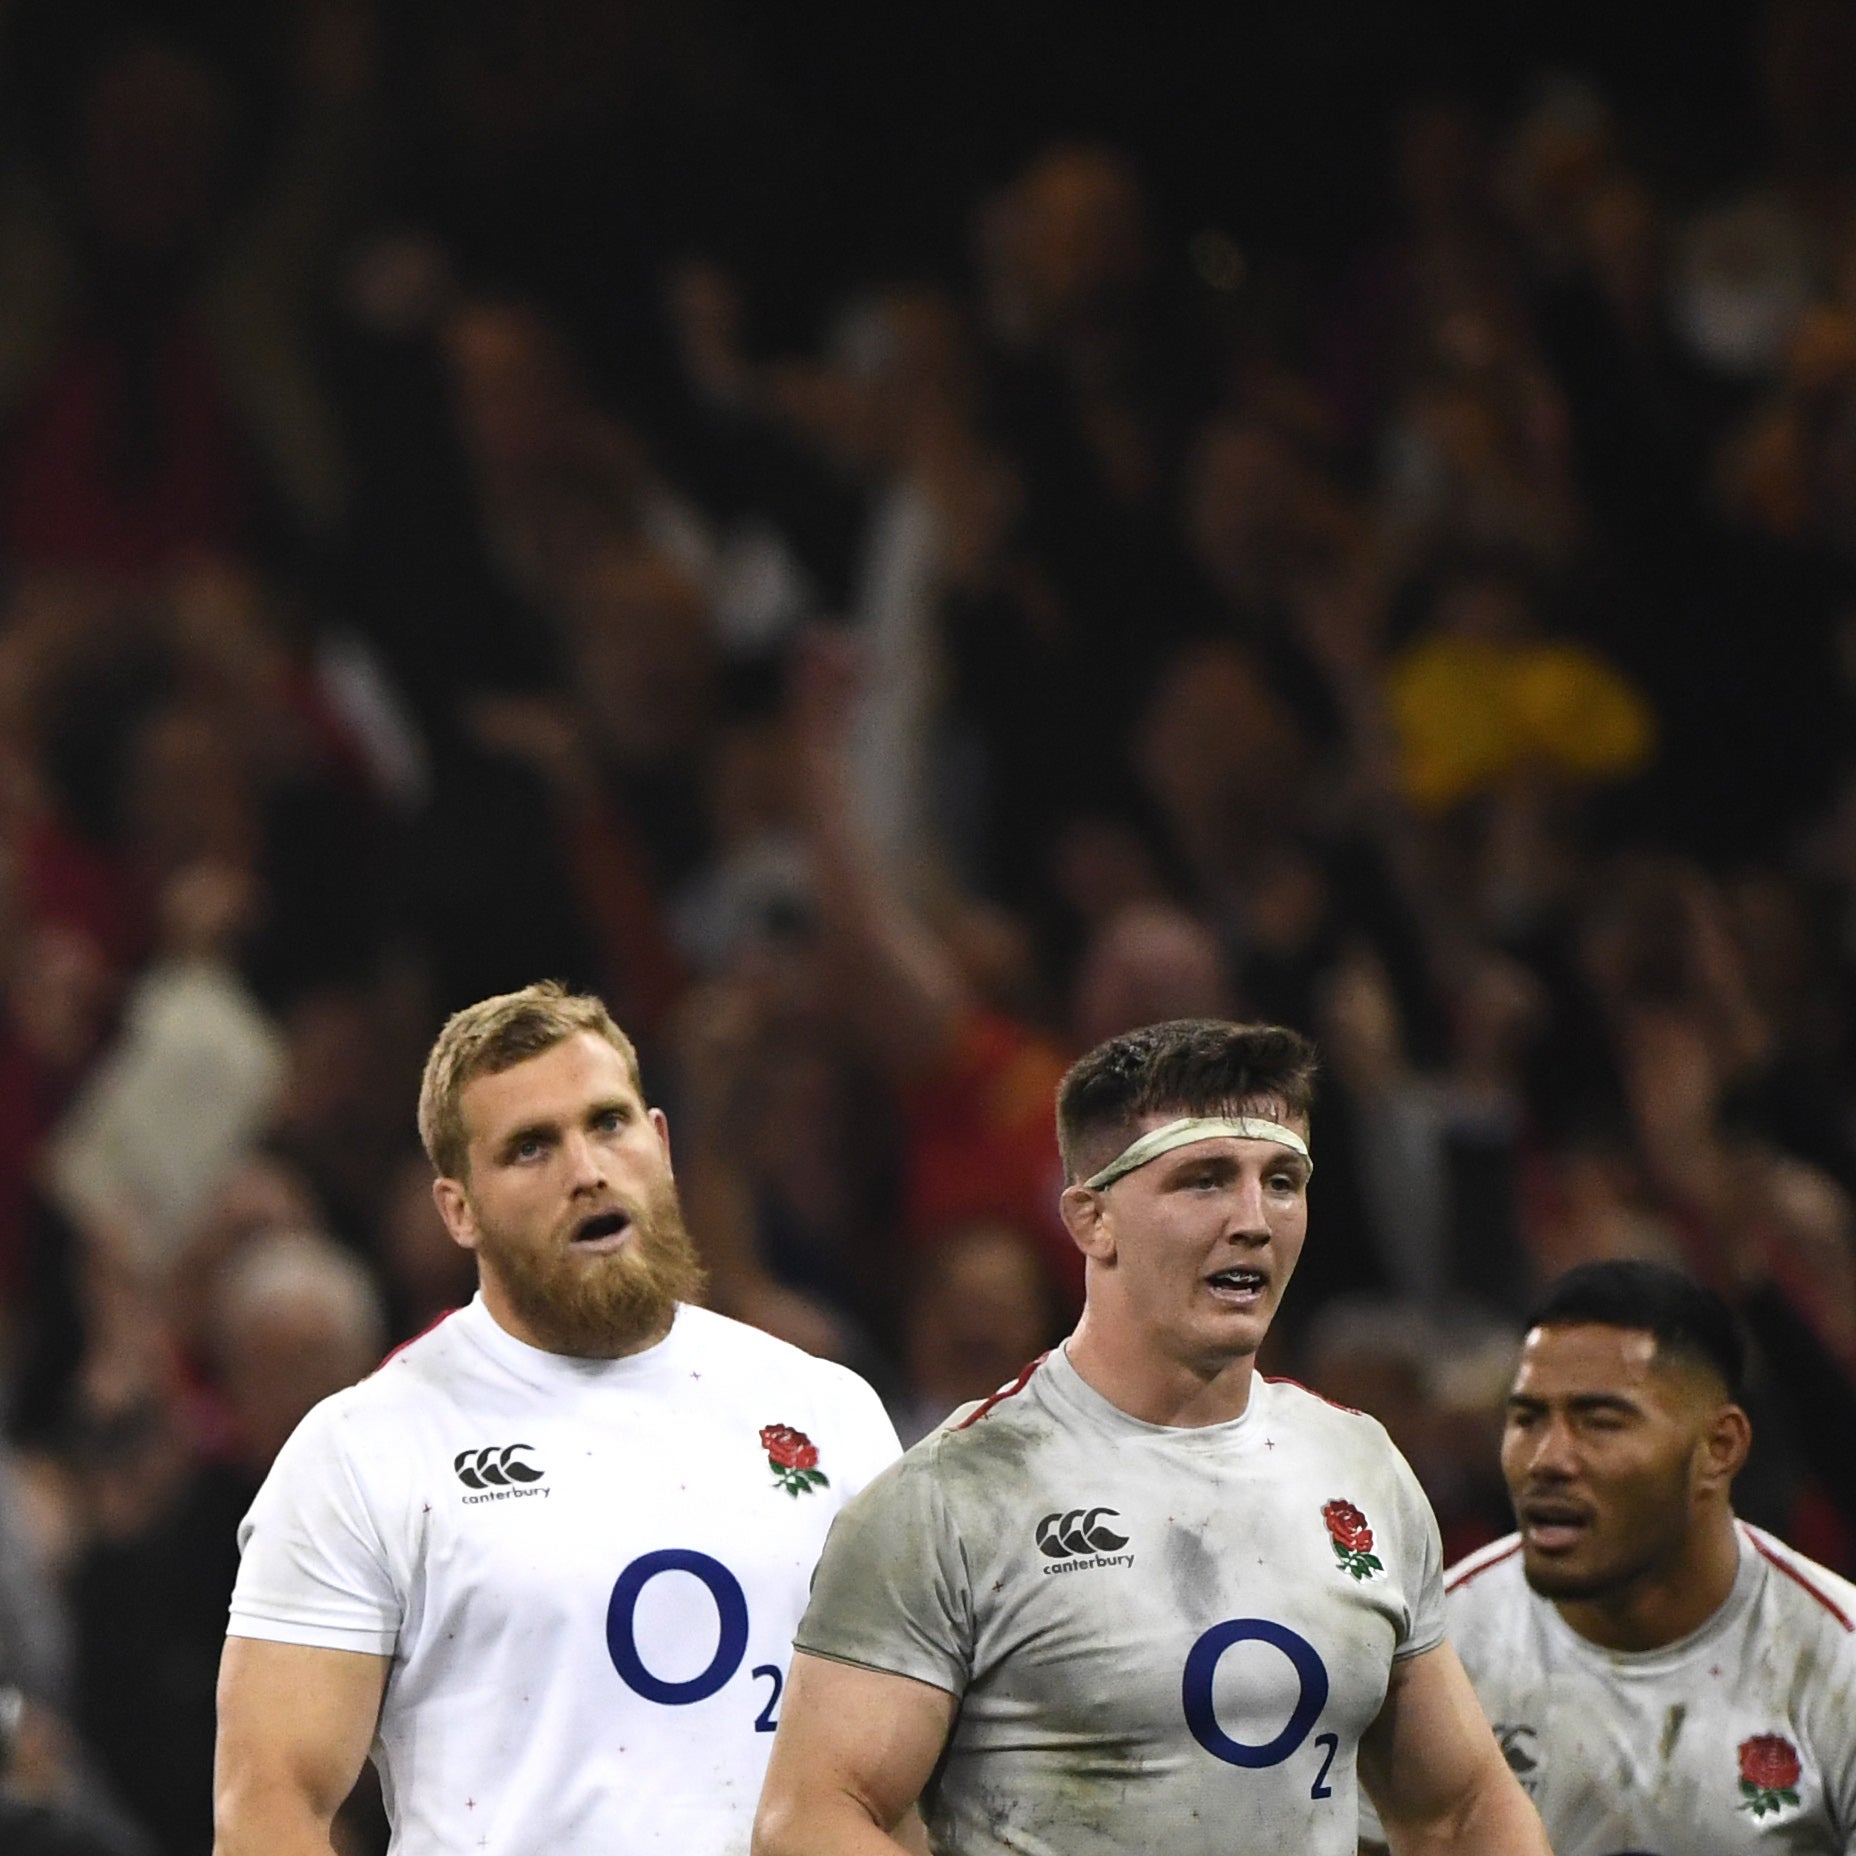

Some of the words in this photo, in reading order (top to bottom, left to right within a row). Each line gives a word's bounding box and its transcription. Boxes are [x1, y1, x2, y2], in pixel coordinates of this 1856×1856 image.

[461, 1486, 551, 1504] canterbury
[1043, 1554, 1135, 1575] canterbury
[605, 1548, 783, 1732] O2
[1182, 1618, 1338, 1800] O2
